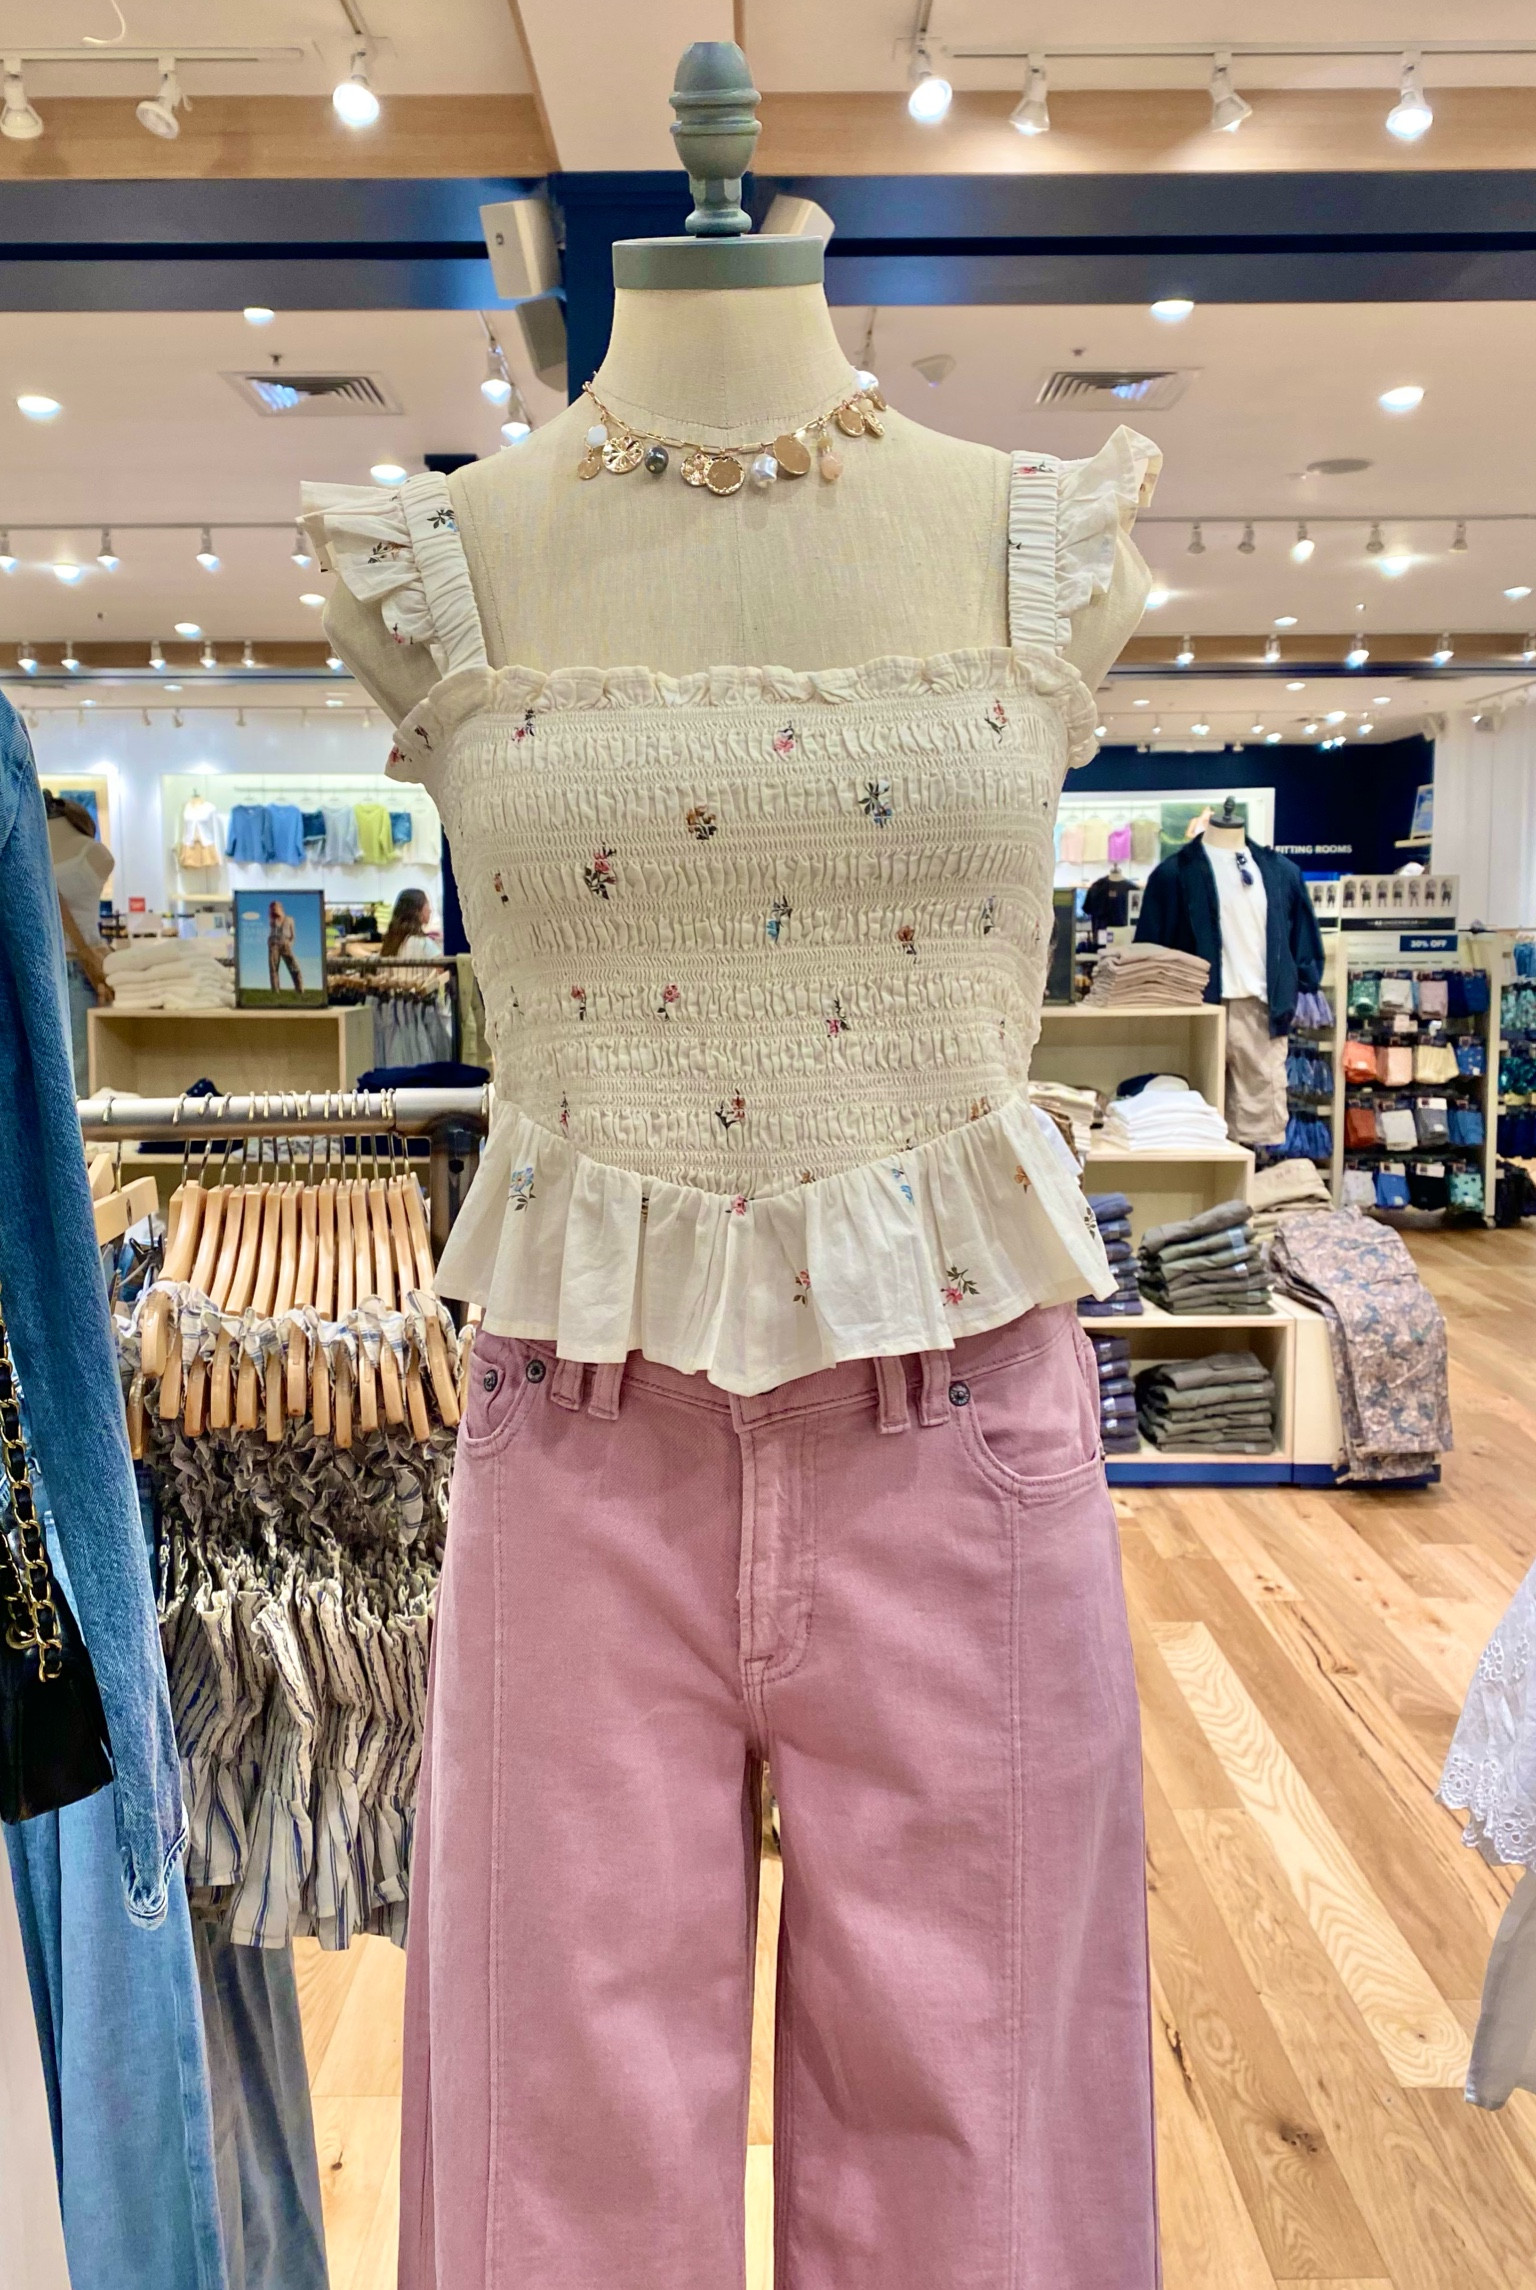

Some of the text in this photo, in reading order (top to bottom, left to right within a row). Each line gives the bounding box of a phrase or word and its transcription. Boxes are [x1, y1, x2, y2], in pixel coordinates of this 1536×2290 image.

[1275, 844, 1352, 854] FITTING ROOMS
[1430, 939, 1448, 948] OFF
